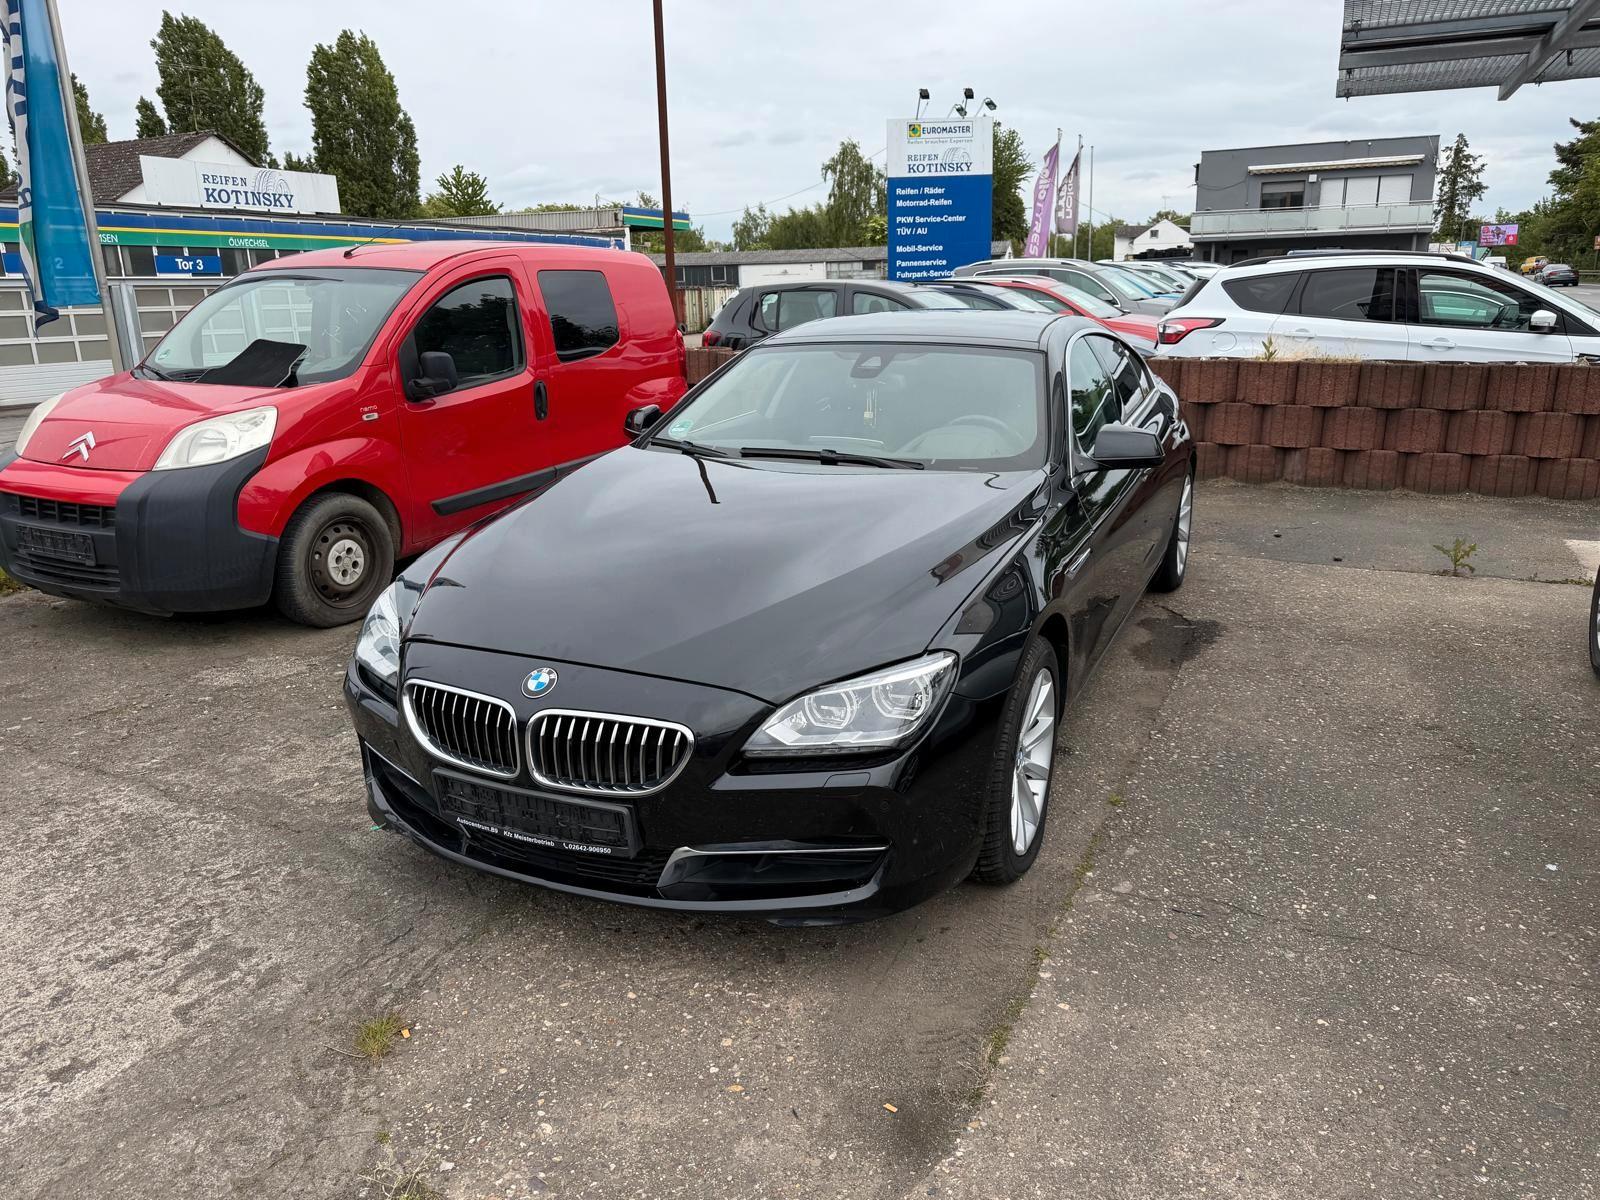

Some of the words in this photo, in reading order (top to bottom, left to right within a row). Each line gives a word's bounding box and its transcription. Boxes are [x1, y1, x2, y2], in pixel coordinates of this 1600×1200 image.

[922, 126, 971, 134] EUROMASTER
[907, 154, 939, 162] REIFEN
[907, 162, 973, 173] KOTINSKY
[202, 174, 247, 187] REIFEN
[896, 187, 918, 195] Reifen
[204, 188, 294, 209] KOTINSKY
[896, 198, 953, 207] Motorrad-Reifen
[896, 216, 914, 224] PKW
[915, 215, 967, 223] Service-Center
[896, 227, 911, 236] TÜV
[916, 227, 928, 235] AU
[1029, 202, 1045, 257] TYRES
[228, 237, 270, 248] ÖLWECHSEL
[896, 244, 944, 253] Mobil-Service
[175, 258, 194, 270] Tor
[196, 259, 204, 271] 3
[896, 259, 948, 267] Pannenservice
[896, 270, 954, 279] Fuhrpark-Service
[503, 830, 513, 838] Kfz
[513, 833, 555, 847] Meisterbetrieb
